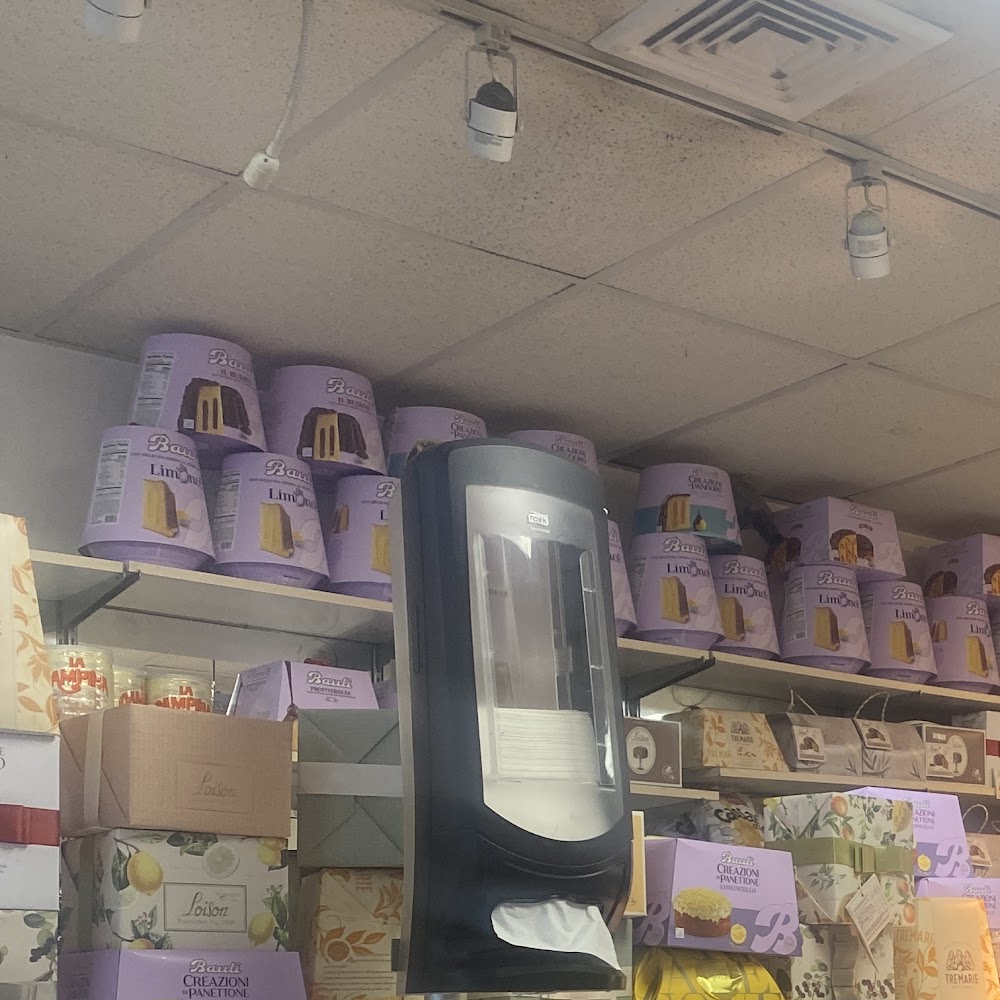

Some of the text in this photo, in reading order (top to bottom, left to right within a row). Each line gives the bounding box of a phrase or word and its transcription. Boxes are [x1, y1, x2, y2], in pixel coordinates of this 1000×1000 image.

[208, 348, 253, 374] Baul
[147, 433, 198, 463] Baul
[529, 515, 548, 525] TORK
[663, 537, 708, 559] Baul
[723, 560, 767, 579] Baul
[69, 657, 85, 668] LA
[306, 670, 354, 689] Bauli
[179, 685, 193, 697] LA
[721, 851, 755, 867] Bauli
[717, 863, 760, 878] CREAZIONI
[720, 874, 760, 887] PANETTONE
[182, 891, 229, 917] Loison
[189, 958, 242, 975] Bauli
[183, 974, 249, 988] CREAZIONI
[945, 973, 980, 985] TREMARIE
[189, 987, 250, 999] PANETTONE
